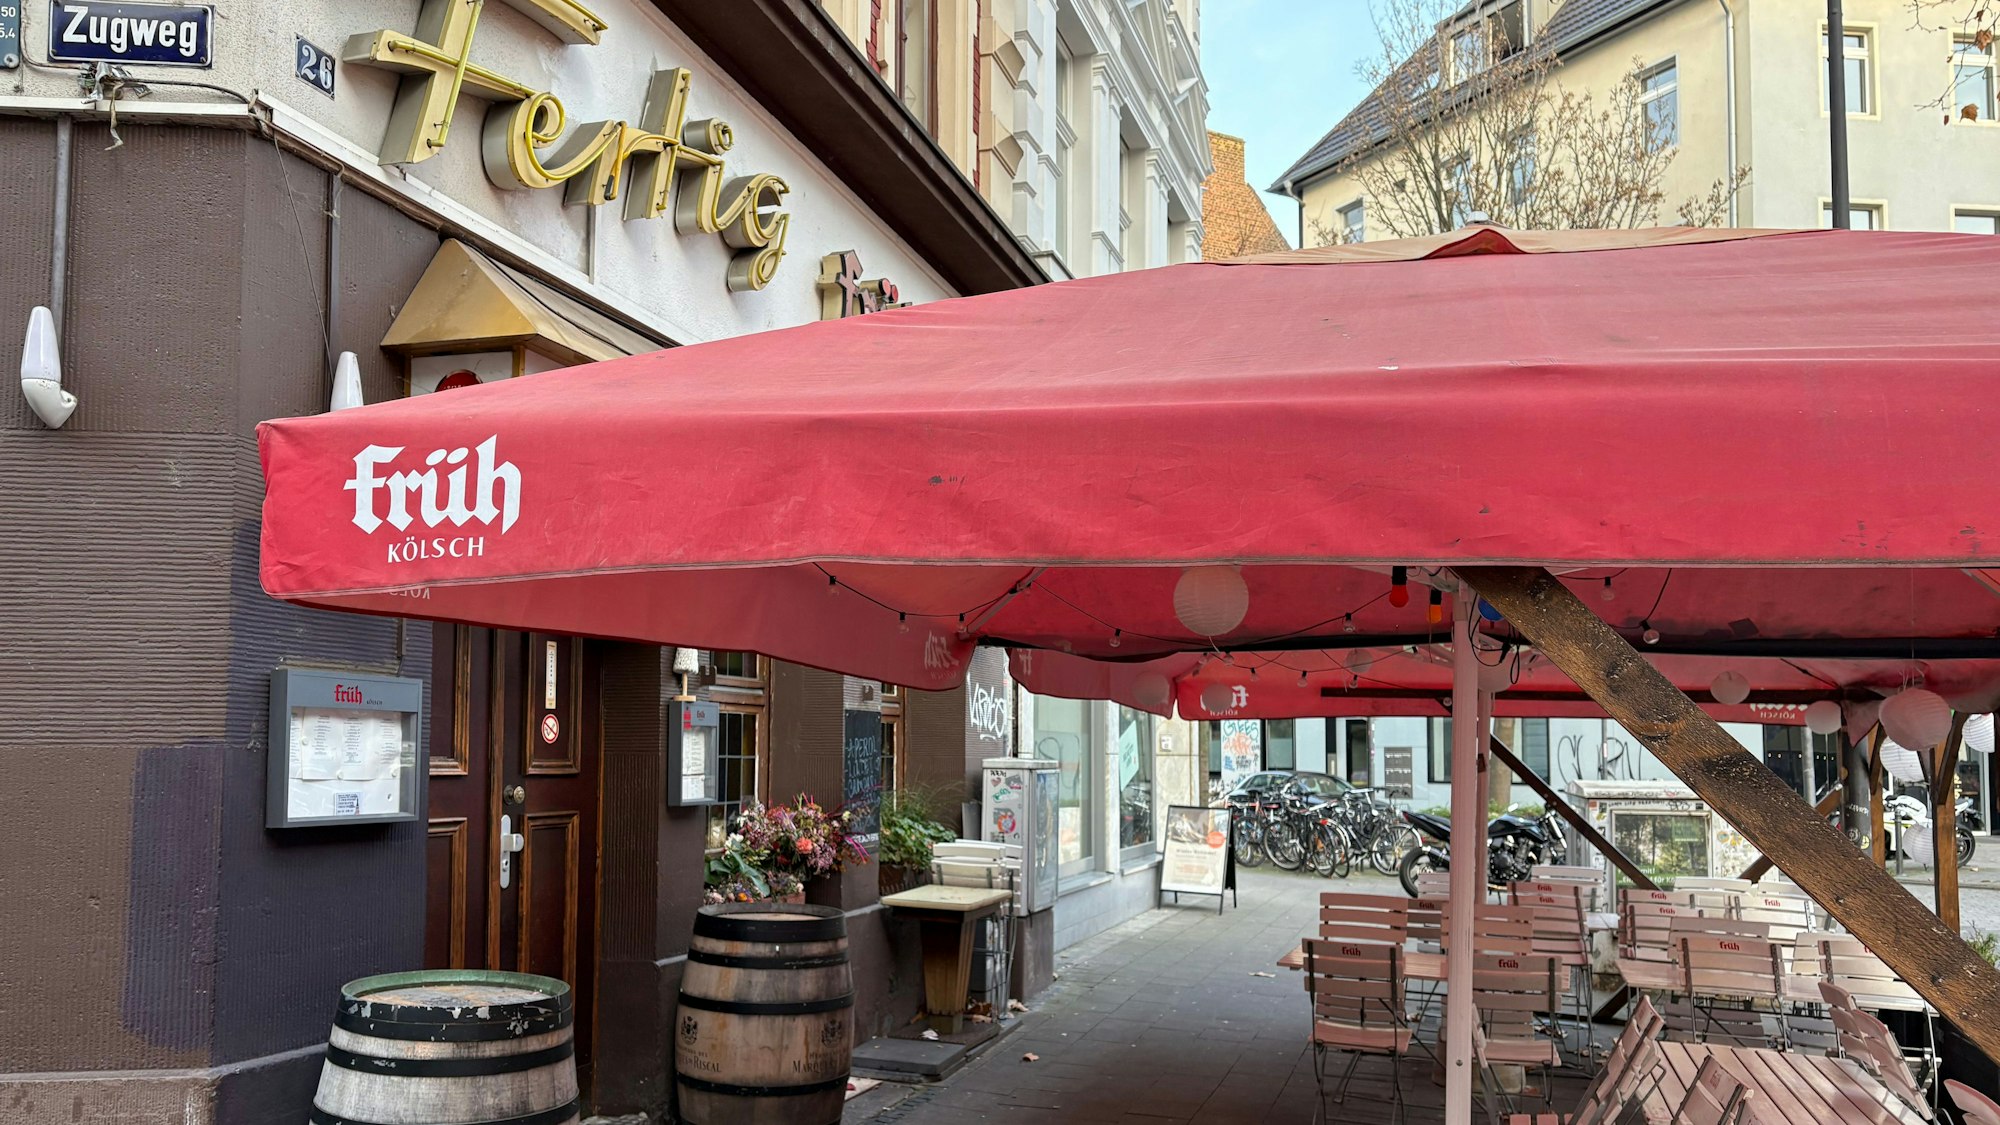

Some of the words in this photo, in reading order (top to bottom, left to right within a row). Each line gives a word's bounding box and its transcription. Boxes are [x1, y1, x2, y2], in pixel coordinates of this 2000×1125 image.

[62, 5, 198, 57] Zugweg
[301, 44, 333, 89] 26
[343, 433, 522, 535] früh
[387, 536, 485, 563] KÖLSCH
[334, 684, 363, 705] früh
[1719, 940, 1740, 951] früh
[1498, 958, 1519, 969] früh
